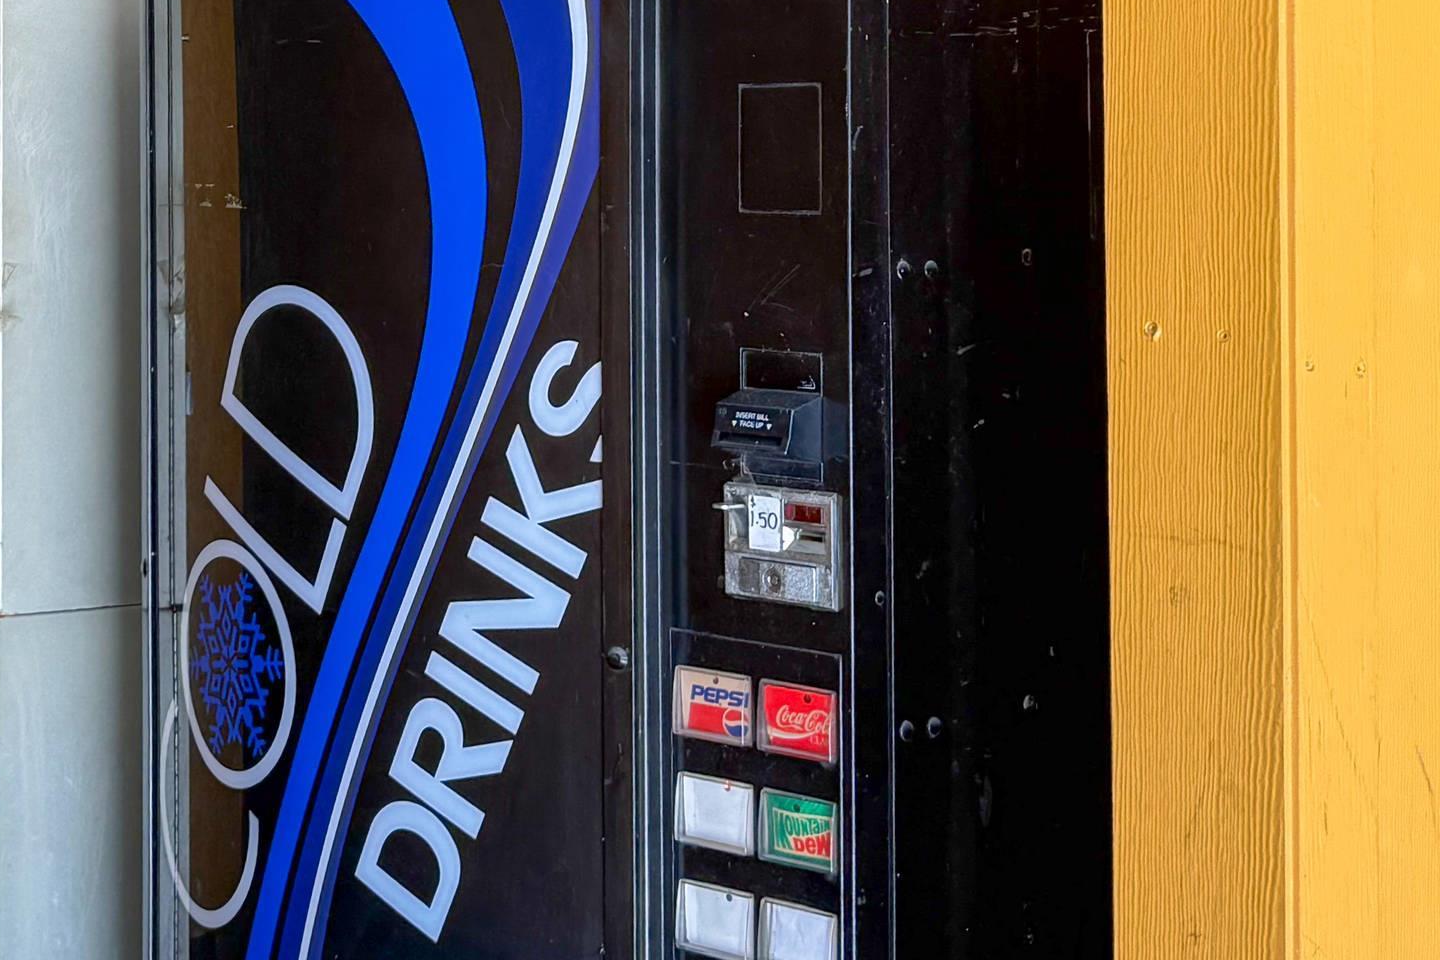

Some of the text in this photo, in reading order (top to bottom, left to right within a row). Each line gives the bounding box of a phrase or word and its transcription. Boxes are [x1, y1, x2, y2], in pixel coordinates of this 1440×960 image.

[740, 419, 755, 428] FACE
[750, 510, 778, 530] 1.50
[160, 284, 374, 928] COLD
[355, 340, 603, 943] DRINKS
[690, 684, 749, 708] PEPSI
